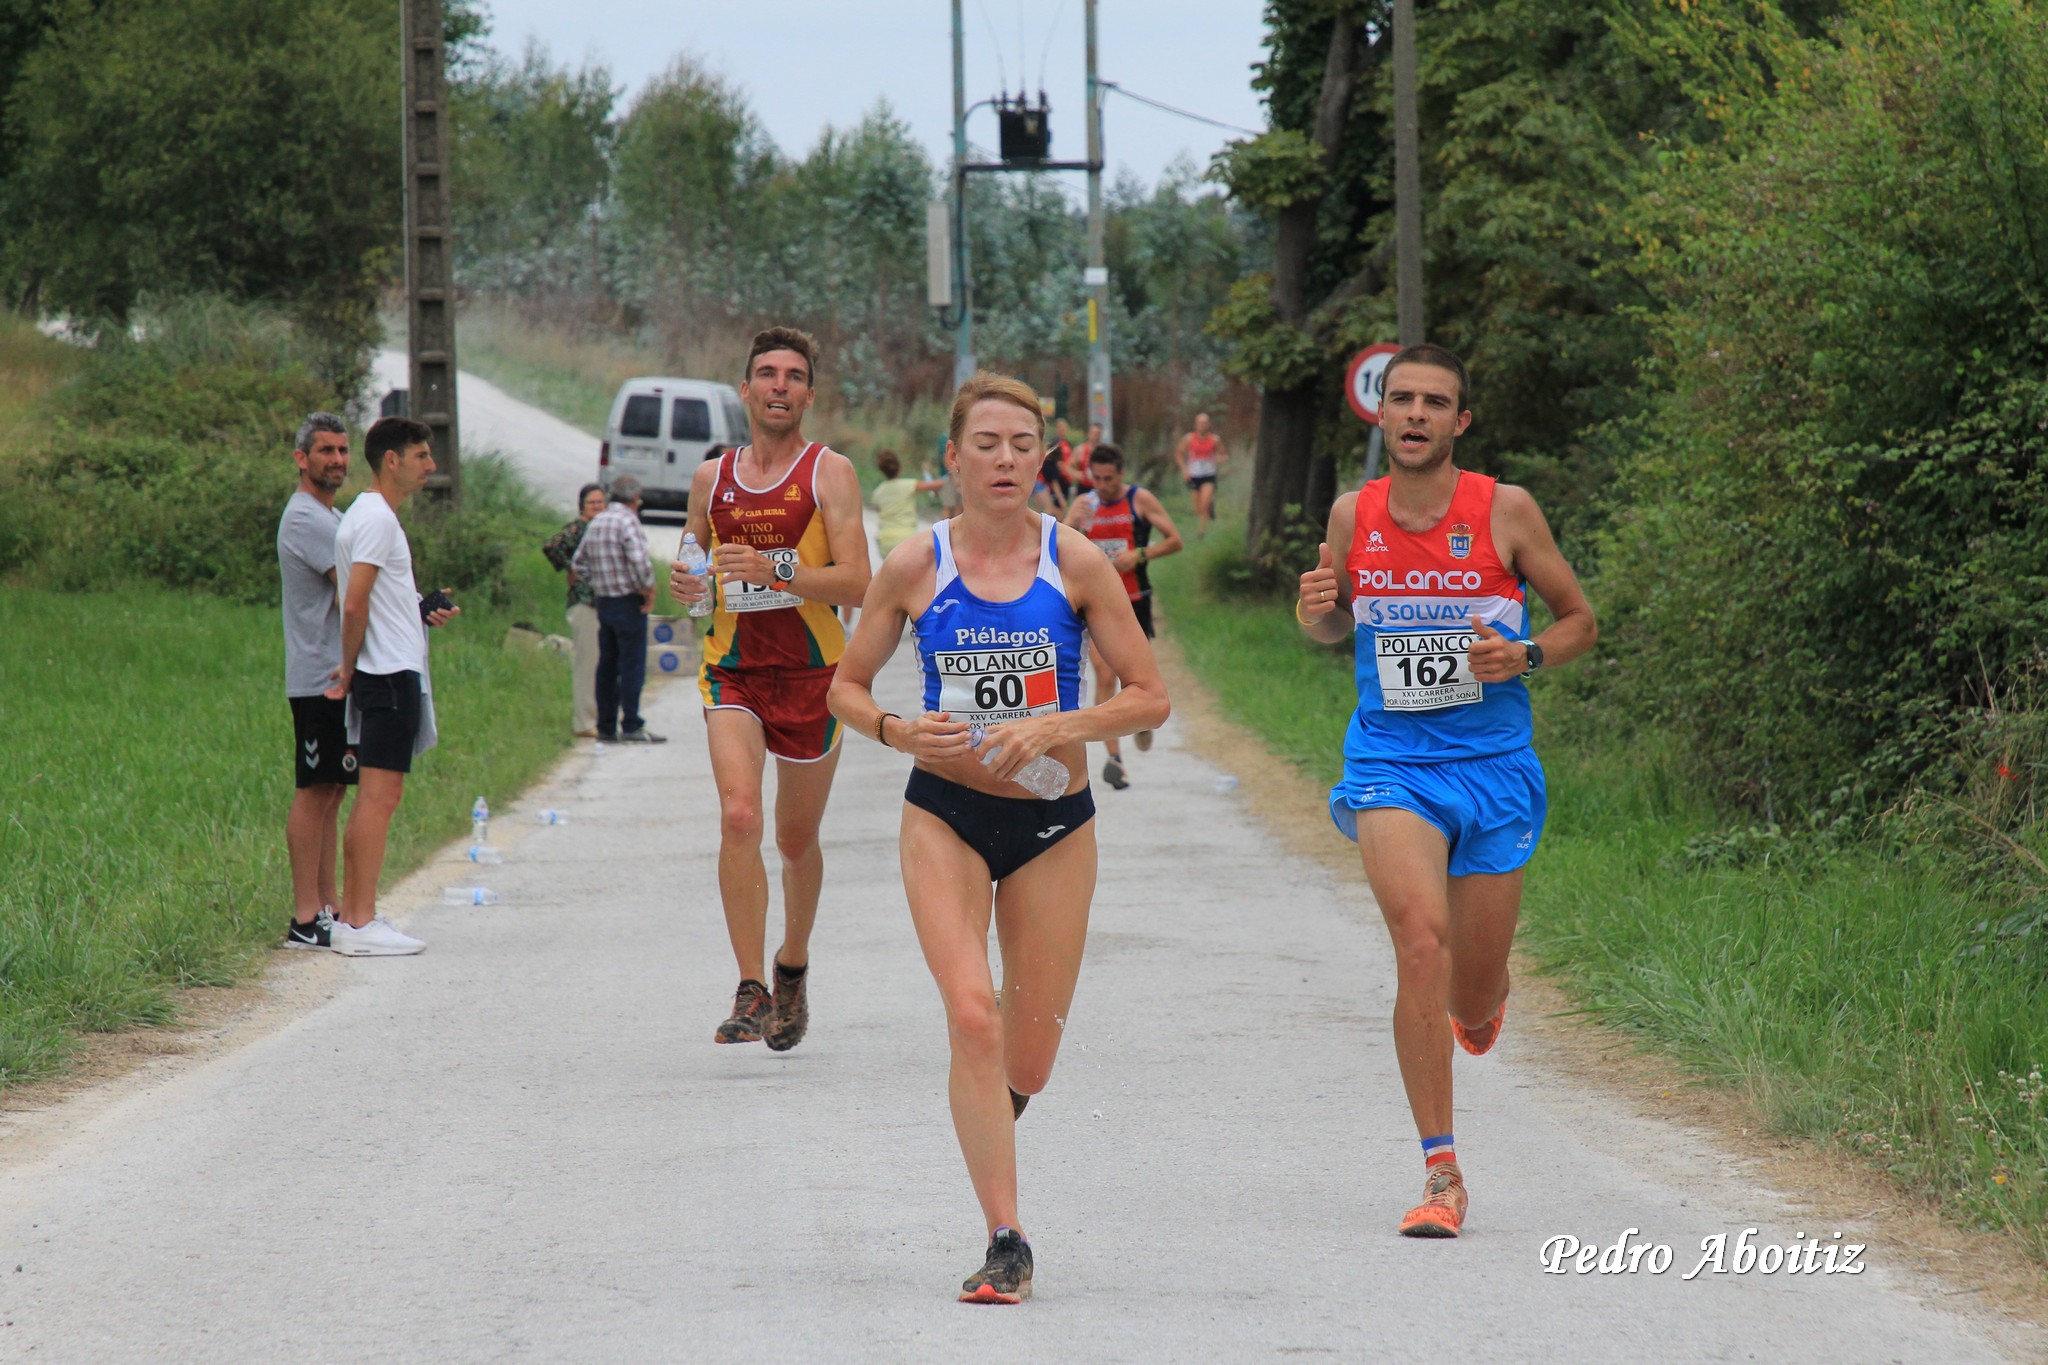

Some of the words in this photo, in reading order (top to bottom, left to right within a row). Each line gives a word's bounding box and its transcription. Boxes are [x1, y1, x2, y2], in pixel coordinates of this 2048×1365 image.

[763, 508, 787, 516] RURAL
[741, 523, 773, 533] VINO
[731, 535, 749, 544] DE
[750, 534, 784, 544] TORO
[1386, 604, 1470, 621] SOLVAY
[1382, 636, 1473, 654] POLANCO
[944, 650, 1049, 673] POLANCO
[1396, 655, 1460, 687] 162
[974, 674, 1024, 710] 60
[1386, 698, 1398, 706] POR
[1412, 696, 1443, 705] MONTES
[1456, 690, 1476, 699] SOÑA
[1418, 687, 1455, 698] CARRERA
[989, 710, 1032, 721] CARRERA
